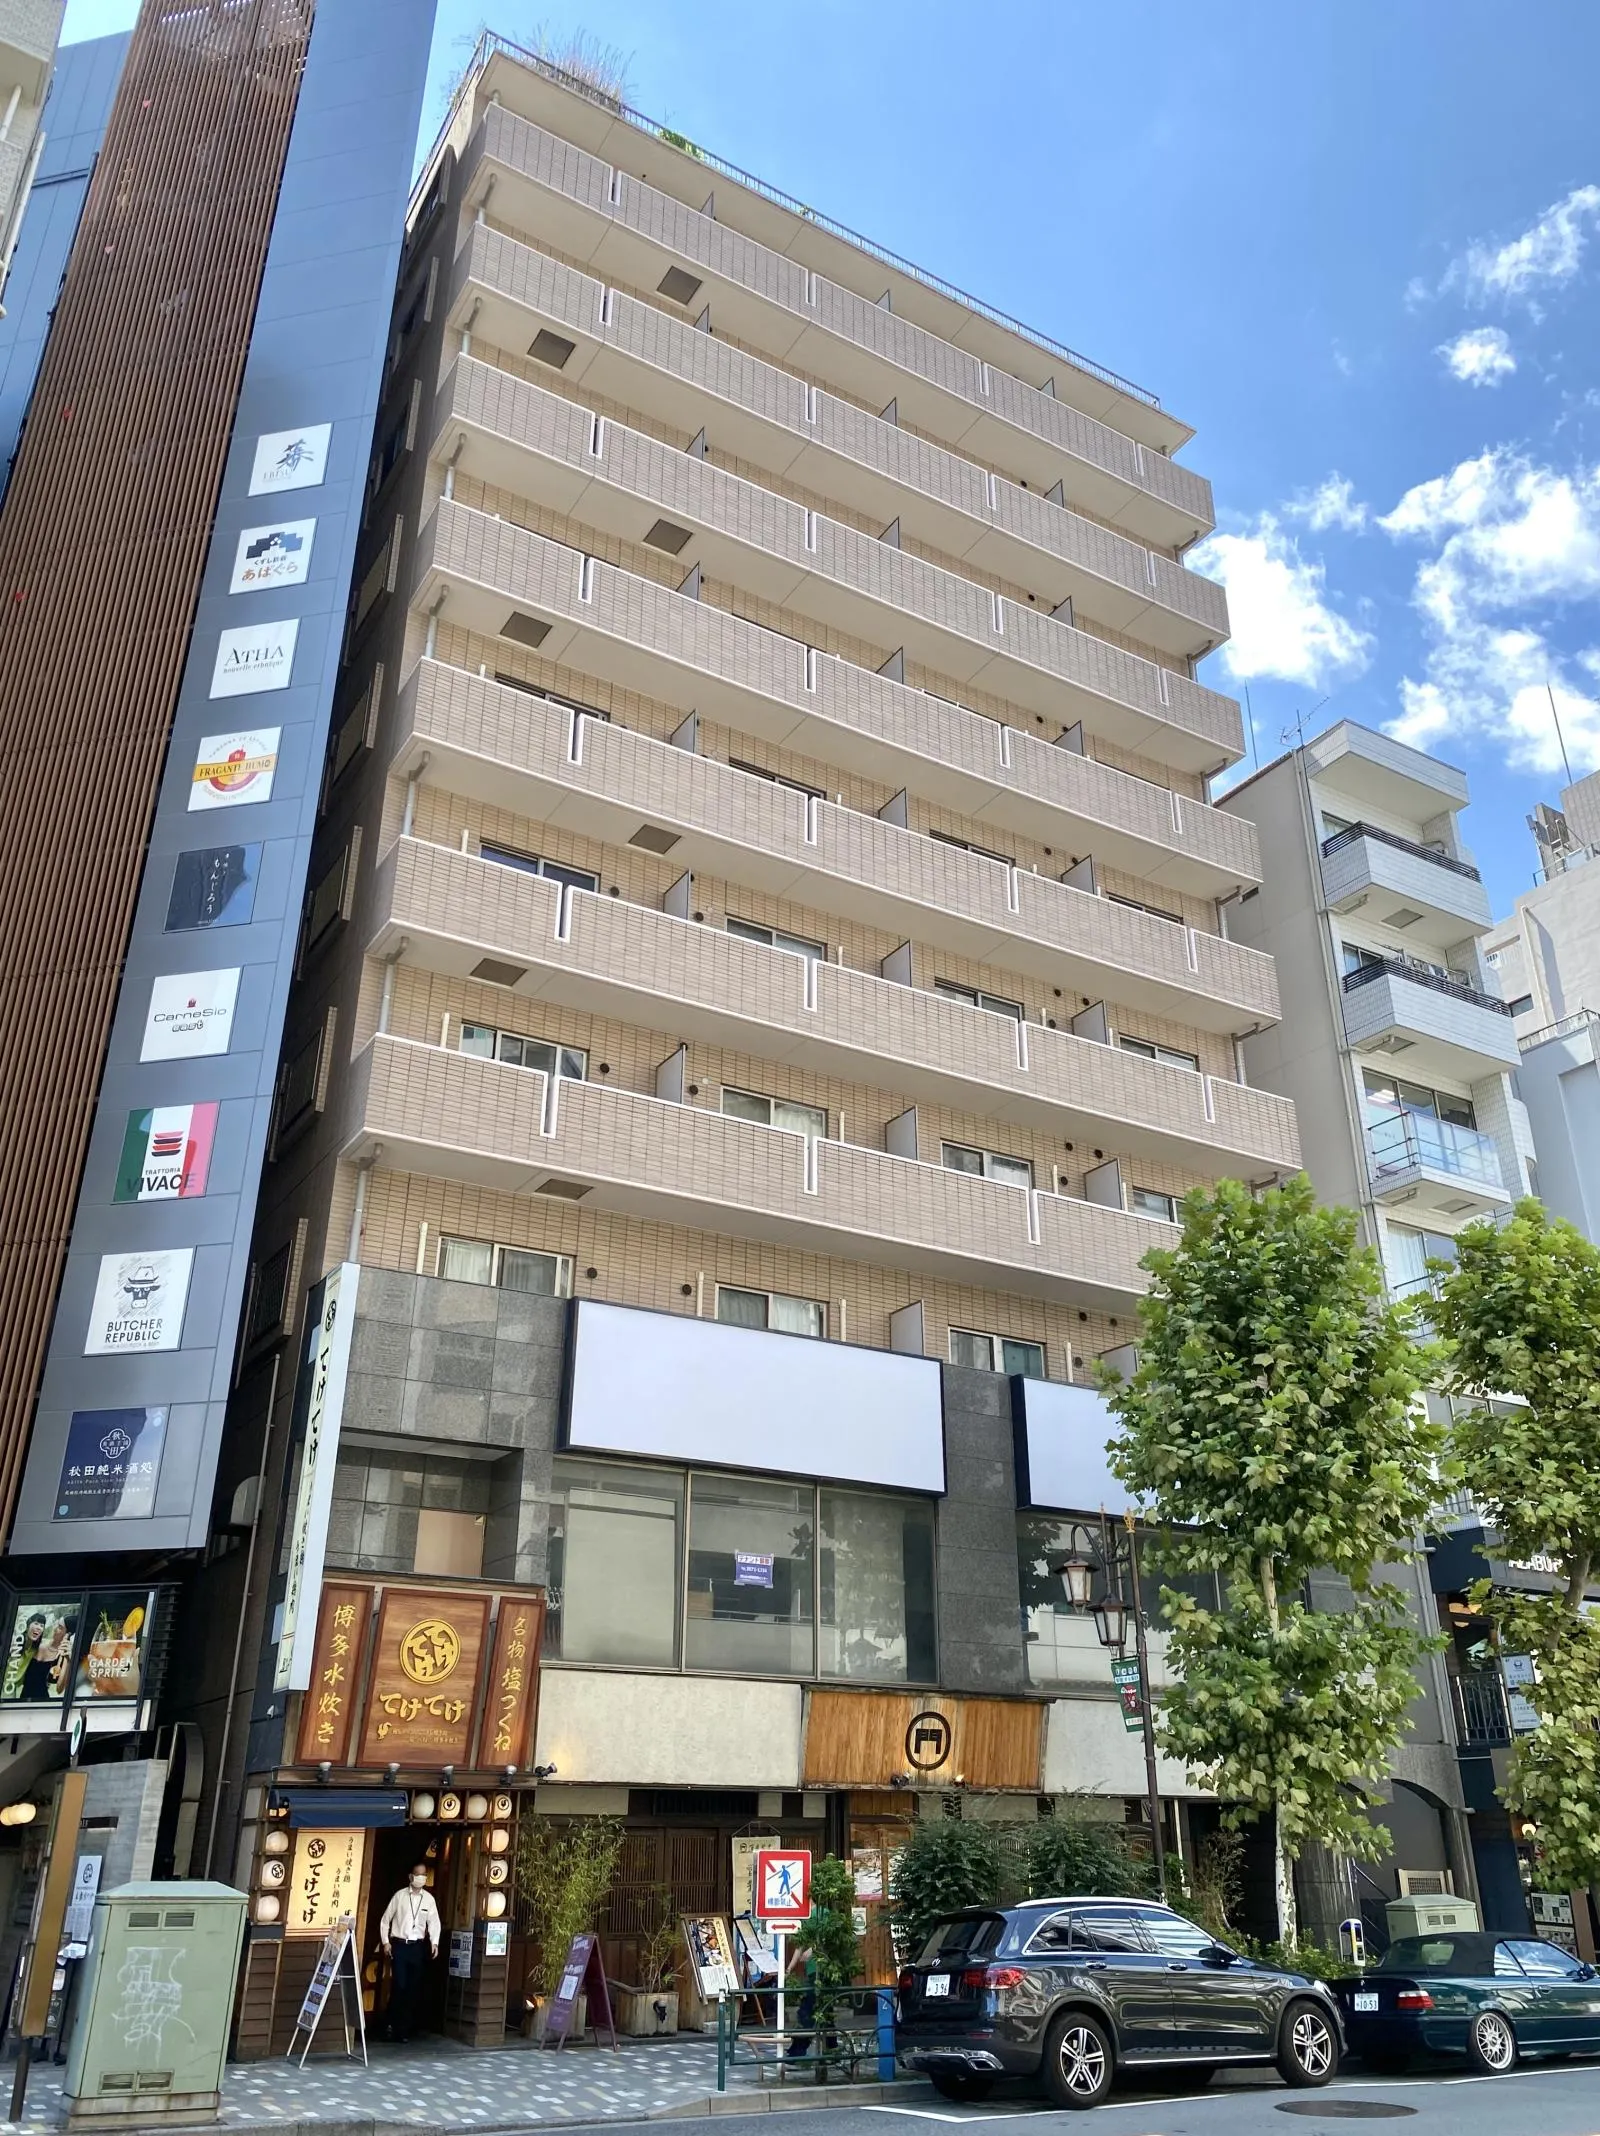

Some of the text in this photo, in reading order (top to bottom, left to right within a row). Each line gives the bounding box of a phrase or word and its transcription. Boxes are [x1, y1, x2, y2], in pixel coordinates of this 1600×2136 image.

[241, 561, 298, 581] あばぐら
[224, 645, 284, 667] ATHA
[199, 764, 241, 777] FRAGANTE
[206, 858, 220, 914] もんじろう
[154, 1006, 227, 1023] CarneSio
[145, 1167, 181, 1176] TRATTORIA
[127, 1173, 195, 1193] VIVACE
[106, 1318, 163, 1333] BUTCHER
[105, 1330, 161, 1343] REPUBLIC
[309, 1347, 329, 1467] てけてけ
[68, 1461, 153, 1477] 秋田純米酒処
[88, 1658, 133, 1668] GARDEN
[90, 1668, 129, 1678] SPRITZ
[317, 1604, 357, 1744] 博多水炊き
[379, 1692, 466, 1724] てけてけ
[302, 1862, 323, 1924] てけてけ
